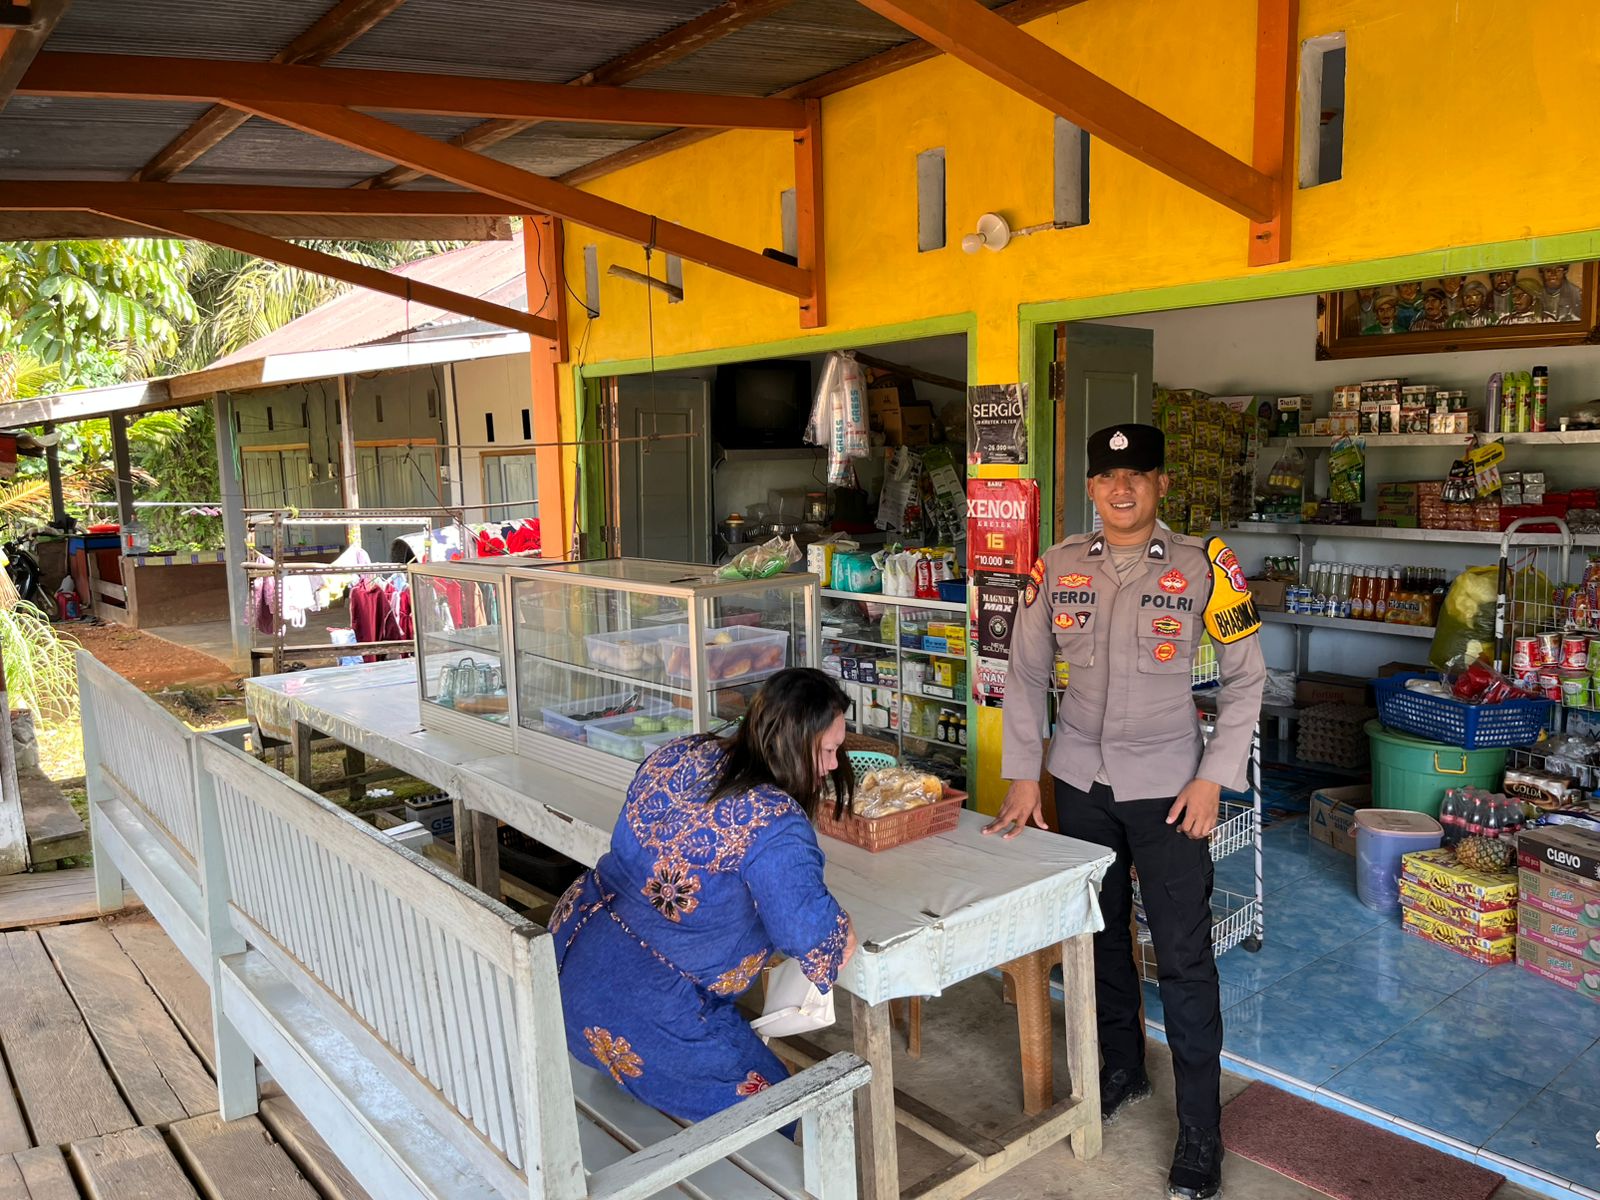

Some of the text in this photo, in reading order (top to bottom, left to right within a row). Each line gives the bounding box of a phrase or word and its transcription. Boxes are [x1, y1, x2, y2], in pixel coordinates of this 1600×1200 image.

[973, 402, 1021, 418] SERGIO
[966, 499, 1026, 520] XENON
[985, 532, 1005, 550] 16
[979, 555, 1003, 566] 10.000
[982, 593, 1015, 605] MAGNUM
[1051, 591, 1096, 605] FERDI
[1141, 594, 1193, 612] POLRI
[983, 602, 1013, 613] MAX
[982, 674, 1006, 684] NAN
[1512, 784, 1542, 798] GOLDA
